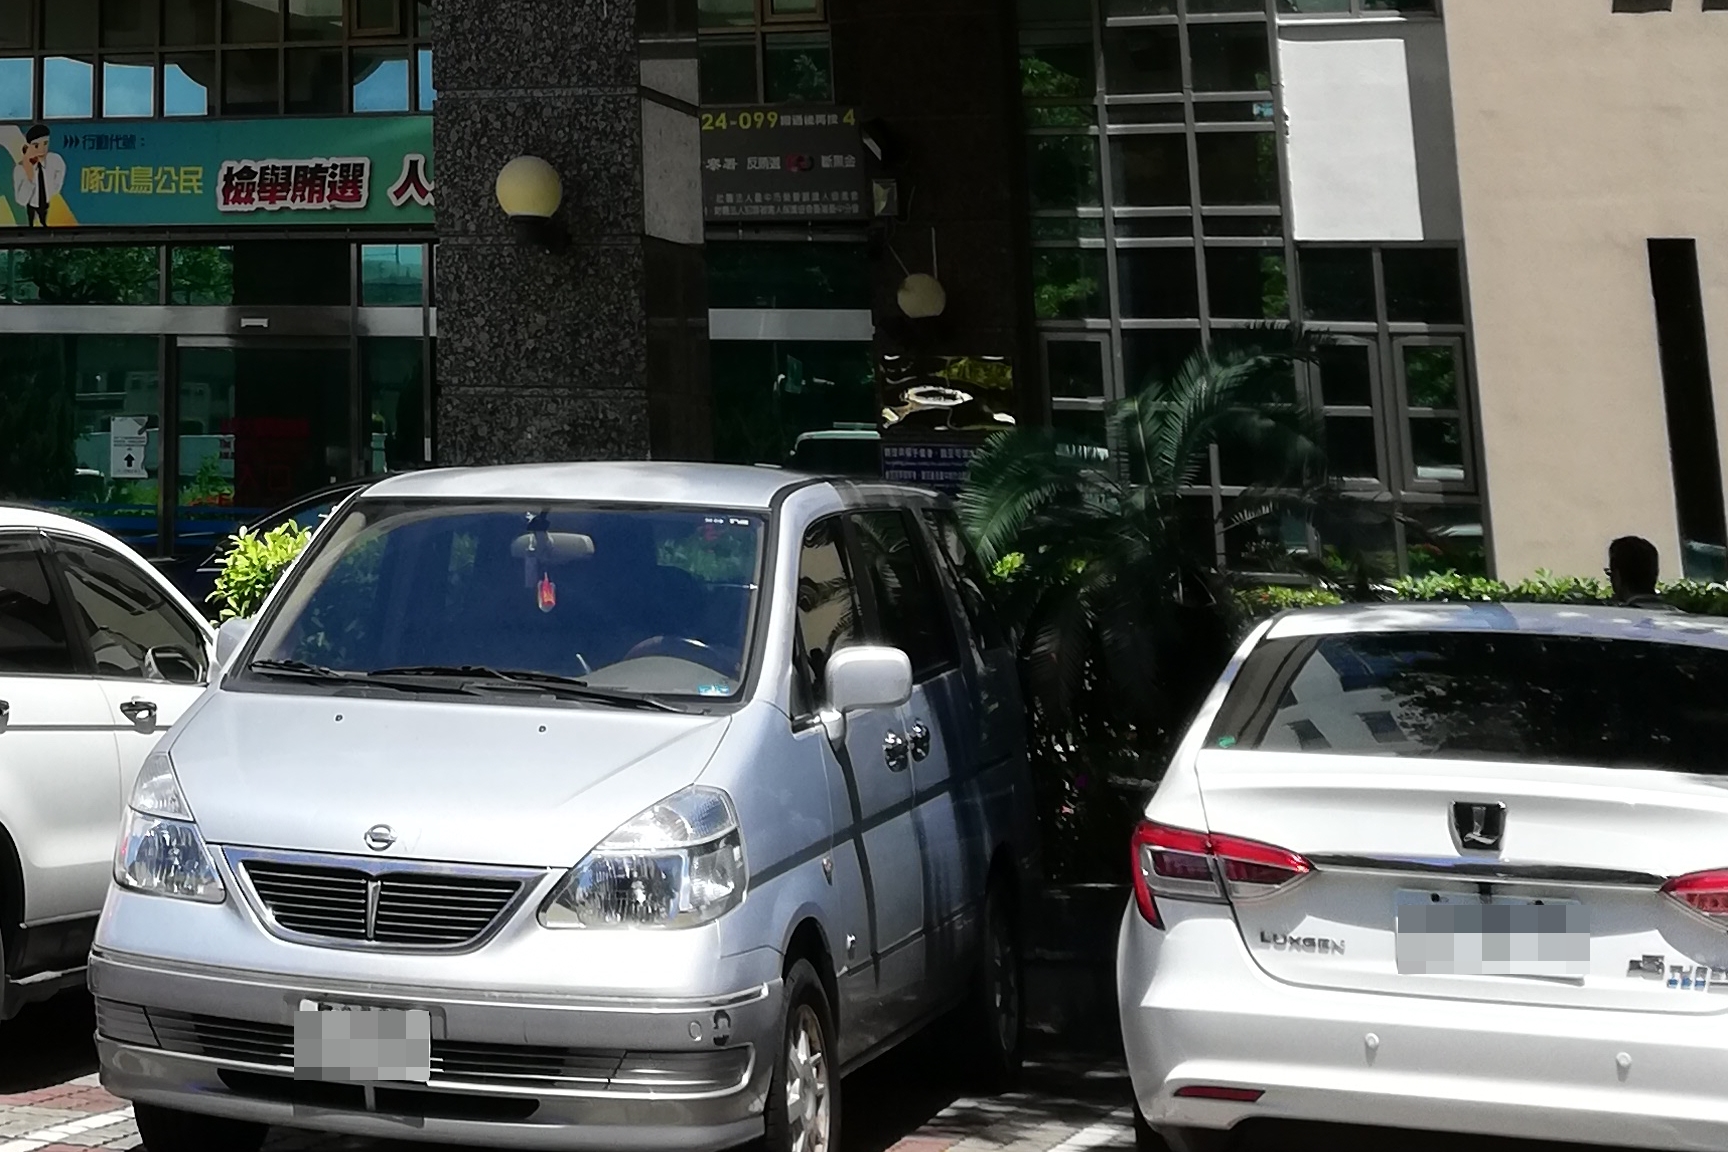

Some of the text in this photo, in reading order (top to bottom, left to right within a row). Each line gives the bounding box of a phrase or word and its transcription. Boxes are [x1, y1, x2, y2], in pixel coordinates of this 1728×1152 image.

[842, 109, 855, 126] 4
[80, 165, 204, 195] 啄木鳥公民
[222, 161, 366, 206] 檢舉賄選
[1260, 931, 1346, 954] LUXGEN
